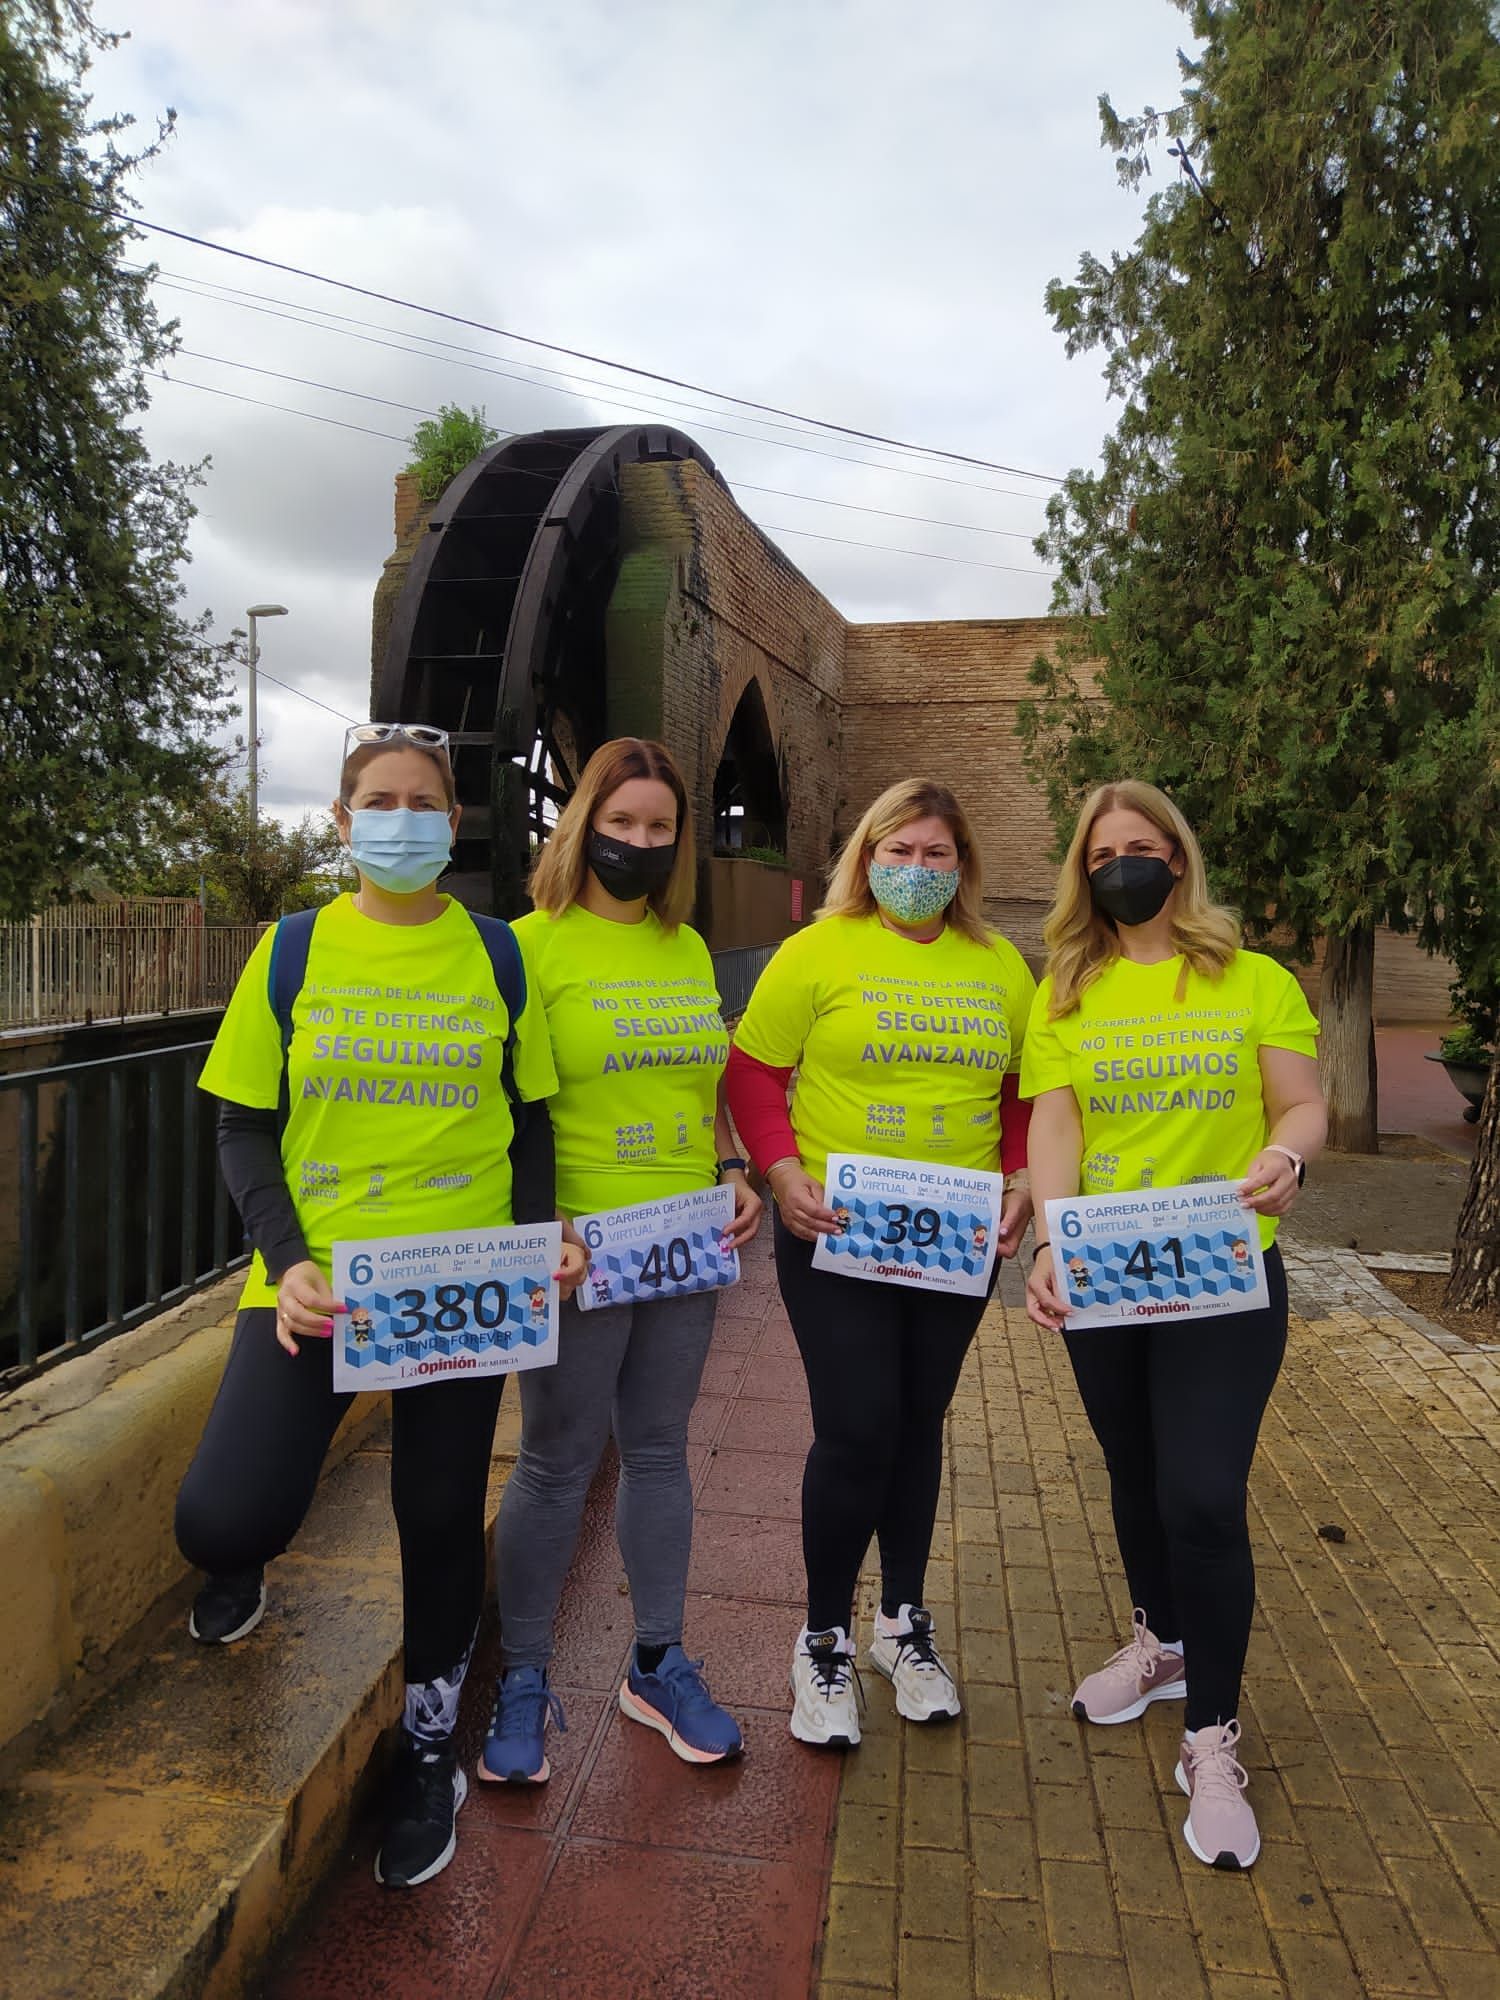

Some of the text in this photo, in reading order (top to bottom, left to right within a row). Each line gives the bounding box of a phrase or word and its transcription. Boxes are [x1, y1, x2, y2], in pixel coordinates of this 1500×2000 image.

[873, 975, 920, 987] CARRERA
[956, 981, 986, 990] MUJER
[322, 985, 381, 998] CARRERA
[386, 987, 401, 999] DE
[407, 989, 421, 1000] LA
[426, 992, 466, 1005] MUJER
[471, 995, 496, 1011] 2021
[592, 997, 619, 1012] NO
[625, 997, 644, 1010] TE
[862, 991, 1003, 1014] NO TE DETENGAS
[307, 1008, 335, 1025] NO
[342, 1008, 367, 1025] TE
[613, 1011, 725, 1038] SEGUIMO
[876, 1011, 1008, 1040] SEGUIMOS
[1095, 1016, 1146, 1027] CARRERA
[1150, 1014, 1164, 1023] DE
[1167, 1012, 1181, 1021] LA
[1185, 1009, 1222, 1019] MUJER
[313, 1035, 483, 1069] SEGUIMOS
[1080, 1027, 1244, 1051] NO TE DETENGAS
[603, 1044, 728, 1074] AVANZAND
[861, 1043, 1008, 1073] AVANZANDO
[1093, 1052, 1239, 1083] SEGUIMOS
[303, 1076, 480, 1109] AVANZANDO
[1089, 1088, 1236, 1114] AVANZANDO
[866, 1125, 906, 1138] Murcia
[617, 1147, 656, 1161] Murcia
[838, 1163, 857, 1190] 6
[862, 1165, 992, 1192] CARRERA DE LA MUJER
[299, 1186, 338, 1200] Murcia
[861, 1180, 990, 1206] VIRTUAL MURCIA
[1086, 1193, 1239, 1219] CARRERA DE LA MUJER
[607, 1206, 661, 1226] CARRERA
[663, 1203, 677, 1215] DE
[678, 1199, 690, 1210] LA
[692, 1190, 728, 1206] MUJER
[584, 1220, 603, 1249] 6
[607, 1206, 728, 1242] VIRTUAL MURCIA
[880, 1203, 942, 1248] 39
[1061, 1210, 1082, 1238] 6
[1088, 1210, 1242, 1235] VIRTUAL MURCIA
[380, 1237, 547, 1264] CARRERA DE LA MUJER
[639, 1237, 692, 1288] 40
[1124, 1237, 1186, 1282] 41
[349, 1254, 374, 1285] 6
[381, 1254, 546, 1281] VIRTUAL MURCIA
[863, 1261, 922, 1280] LaOpinión
[393, 1280, 508, 1340] 380
[1120, 1301, 1191, 1317] LaOpinión
[388, 1331, 513, 1355] FRIENDS FOREVER
[400, 1356, 477, 1378] LaOpinión
[489, 1357, 519, 1367] MURCIA
